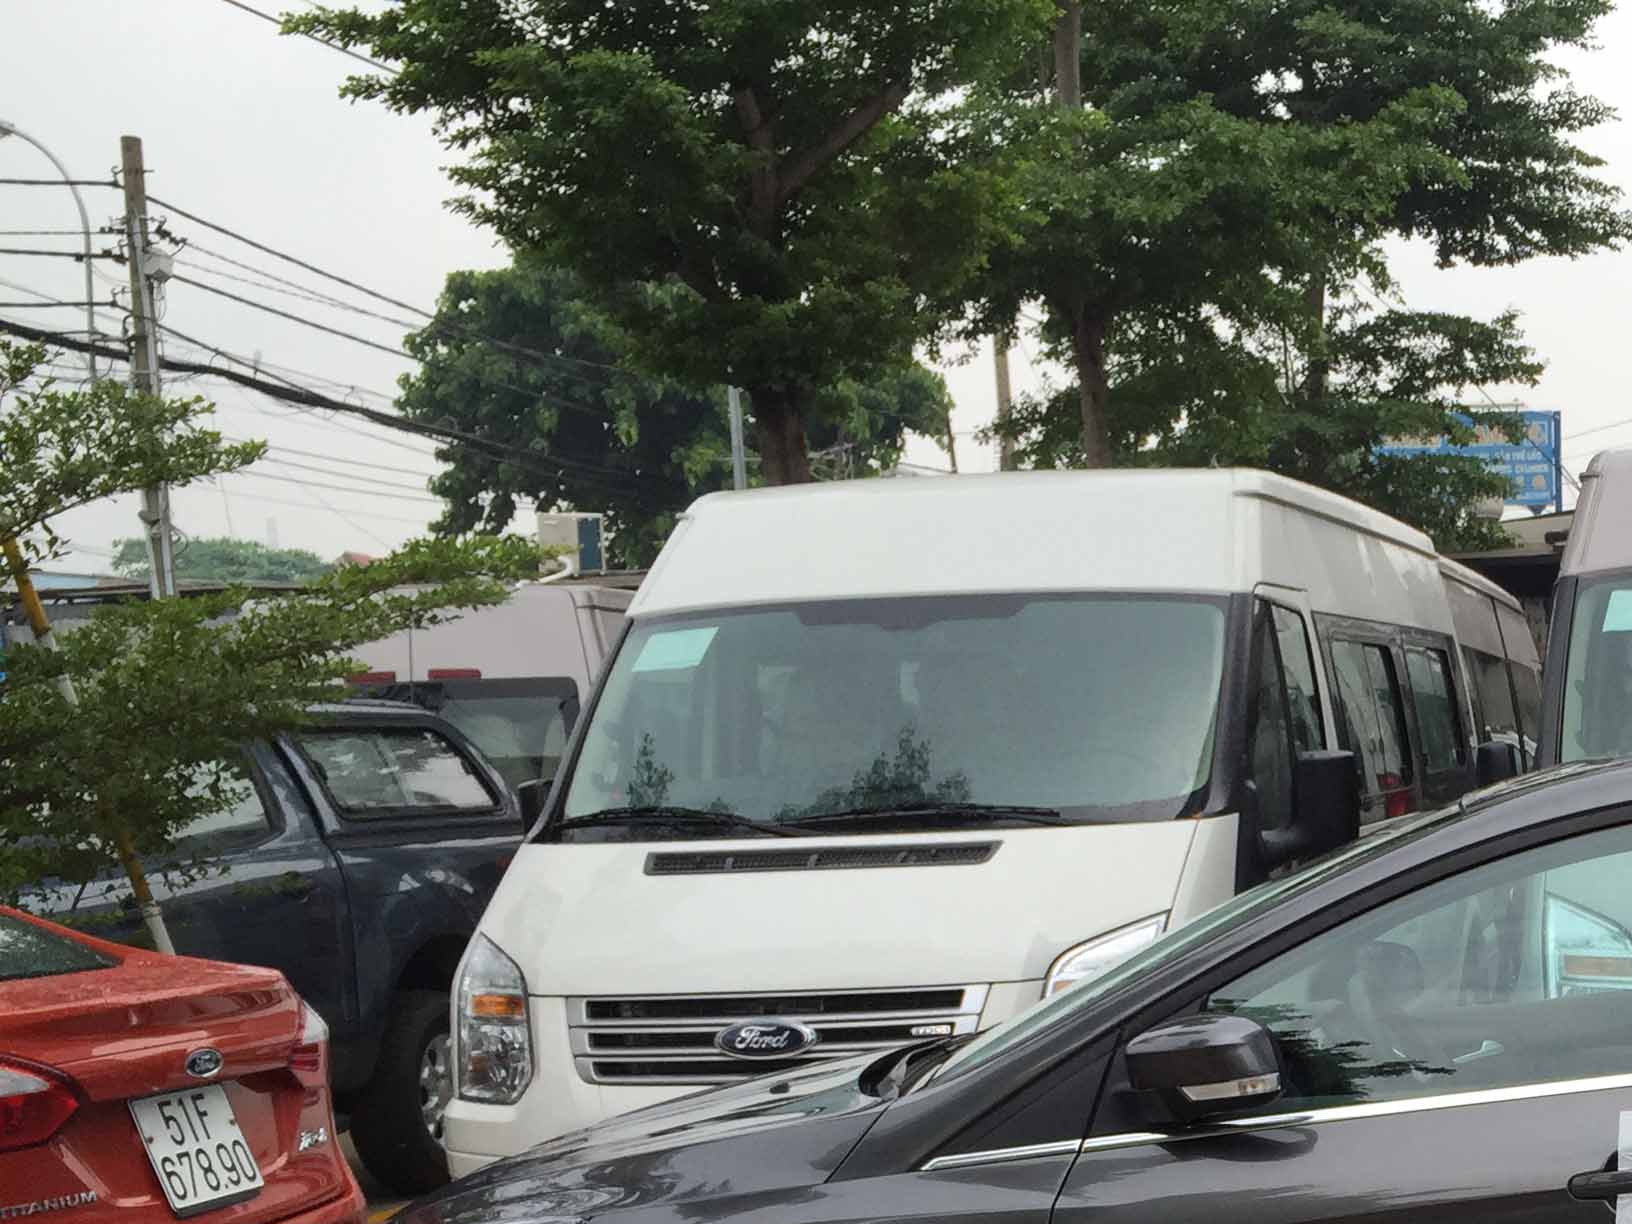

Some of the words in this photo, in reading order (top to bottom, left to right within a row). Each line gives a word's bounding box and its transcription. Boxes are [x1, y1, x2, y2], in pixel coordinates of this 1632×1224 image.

[735, 1026, 790, 1049] Ford
[156, 1092, 211, 1147] 51F
[160, 1139, 257, 1201] 678.90
